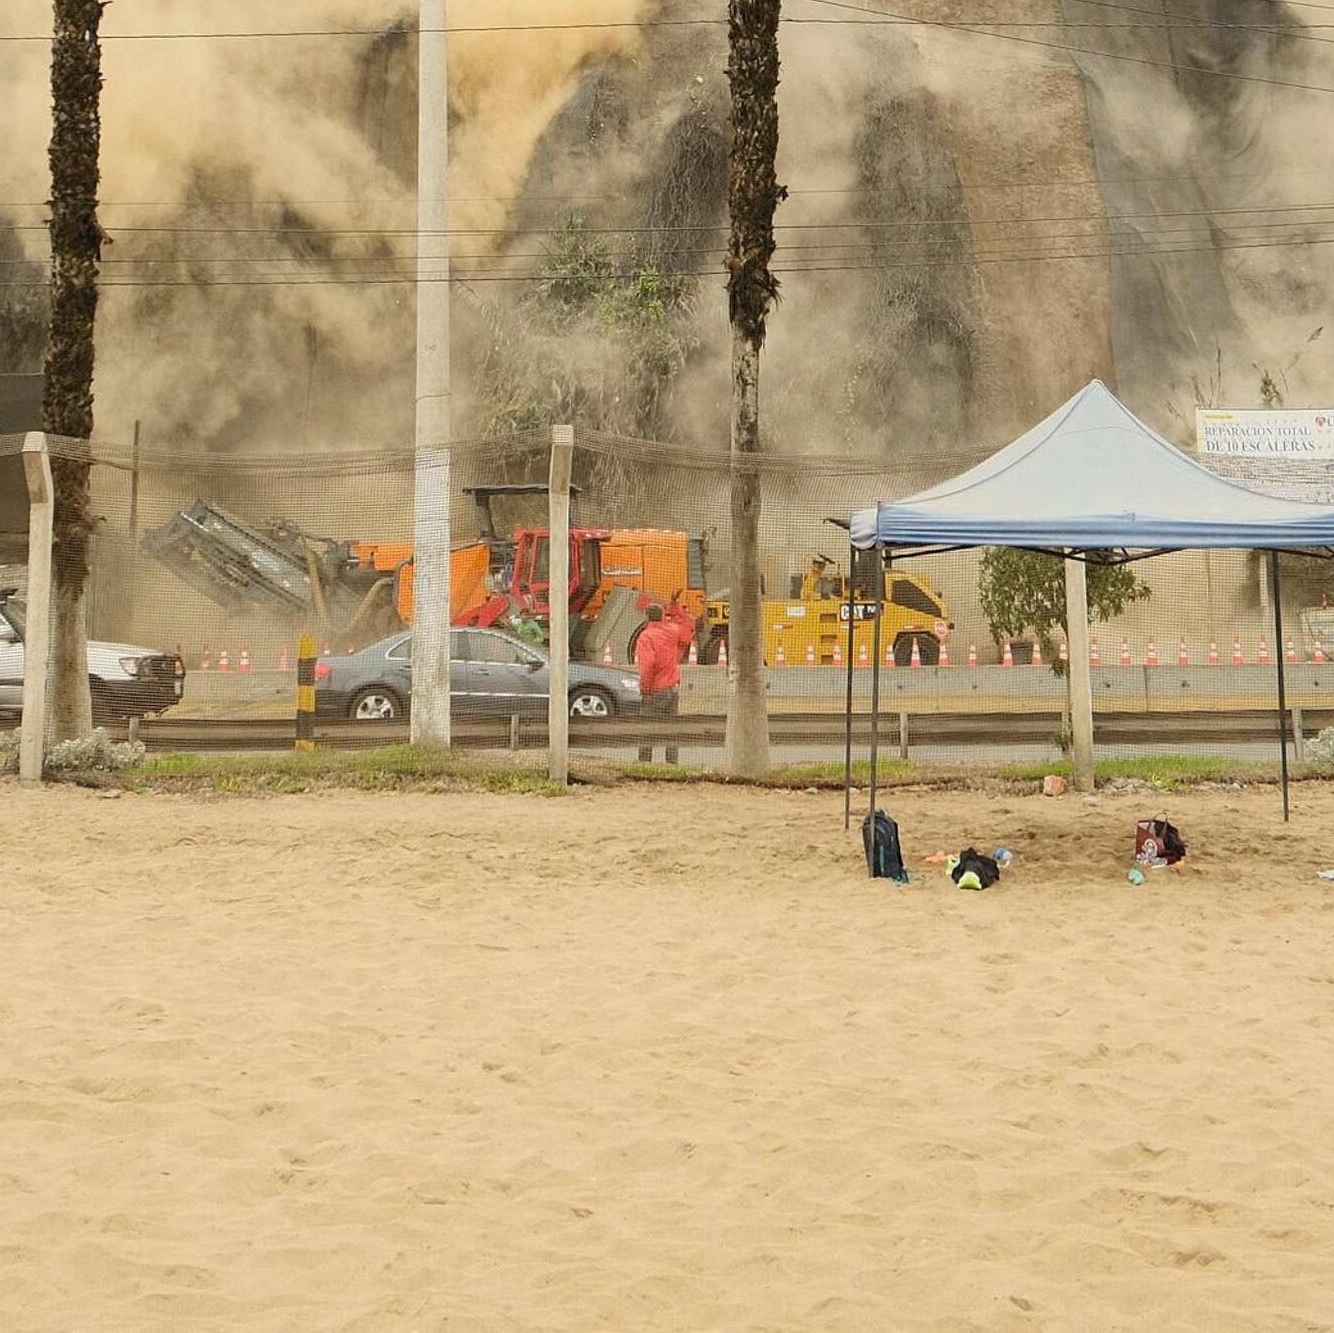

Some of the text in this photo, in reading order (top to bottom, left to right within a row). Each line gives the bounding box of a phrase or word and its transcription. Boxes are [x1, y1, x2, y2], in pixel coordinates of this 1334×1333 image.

[1276, 426, 1308, 437] TOTAL
[1206, 440, 1316, 452] DE 10 ESCALERAS
